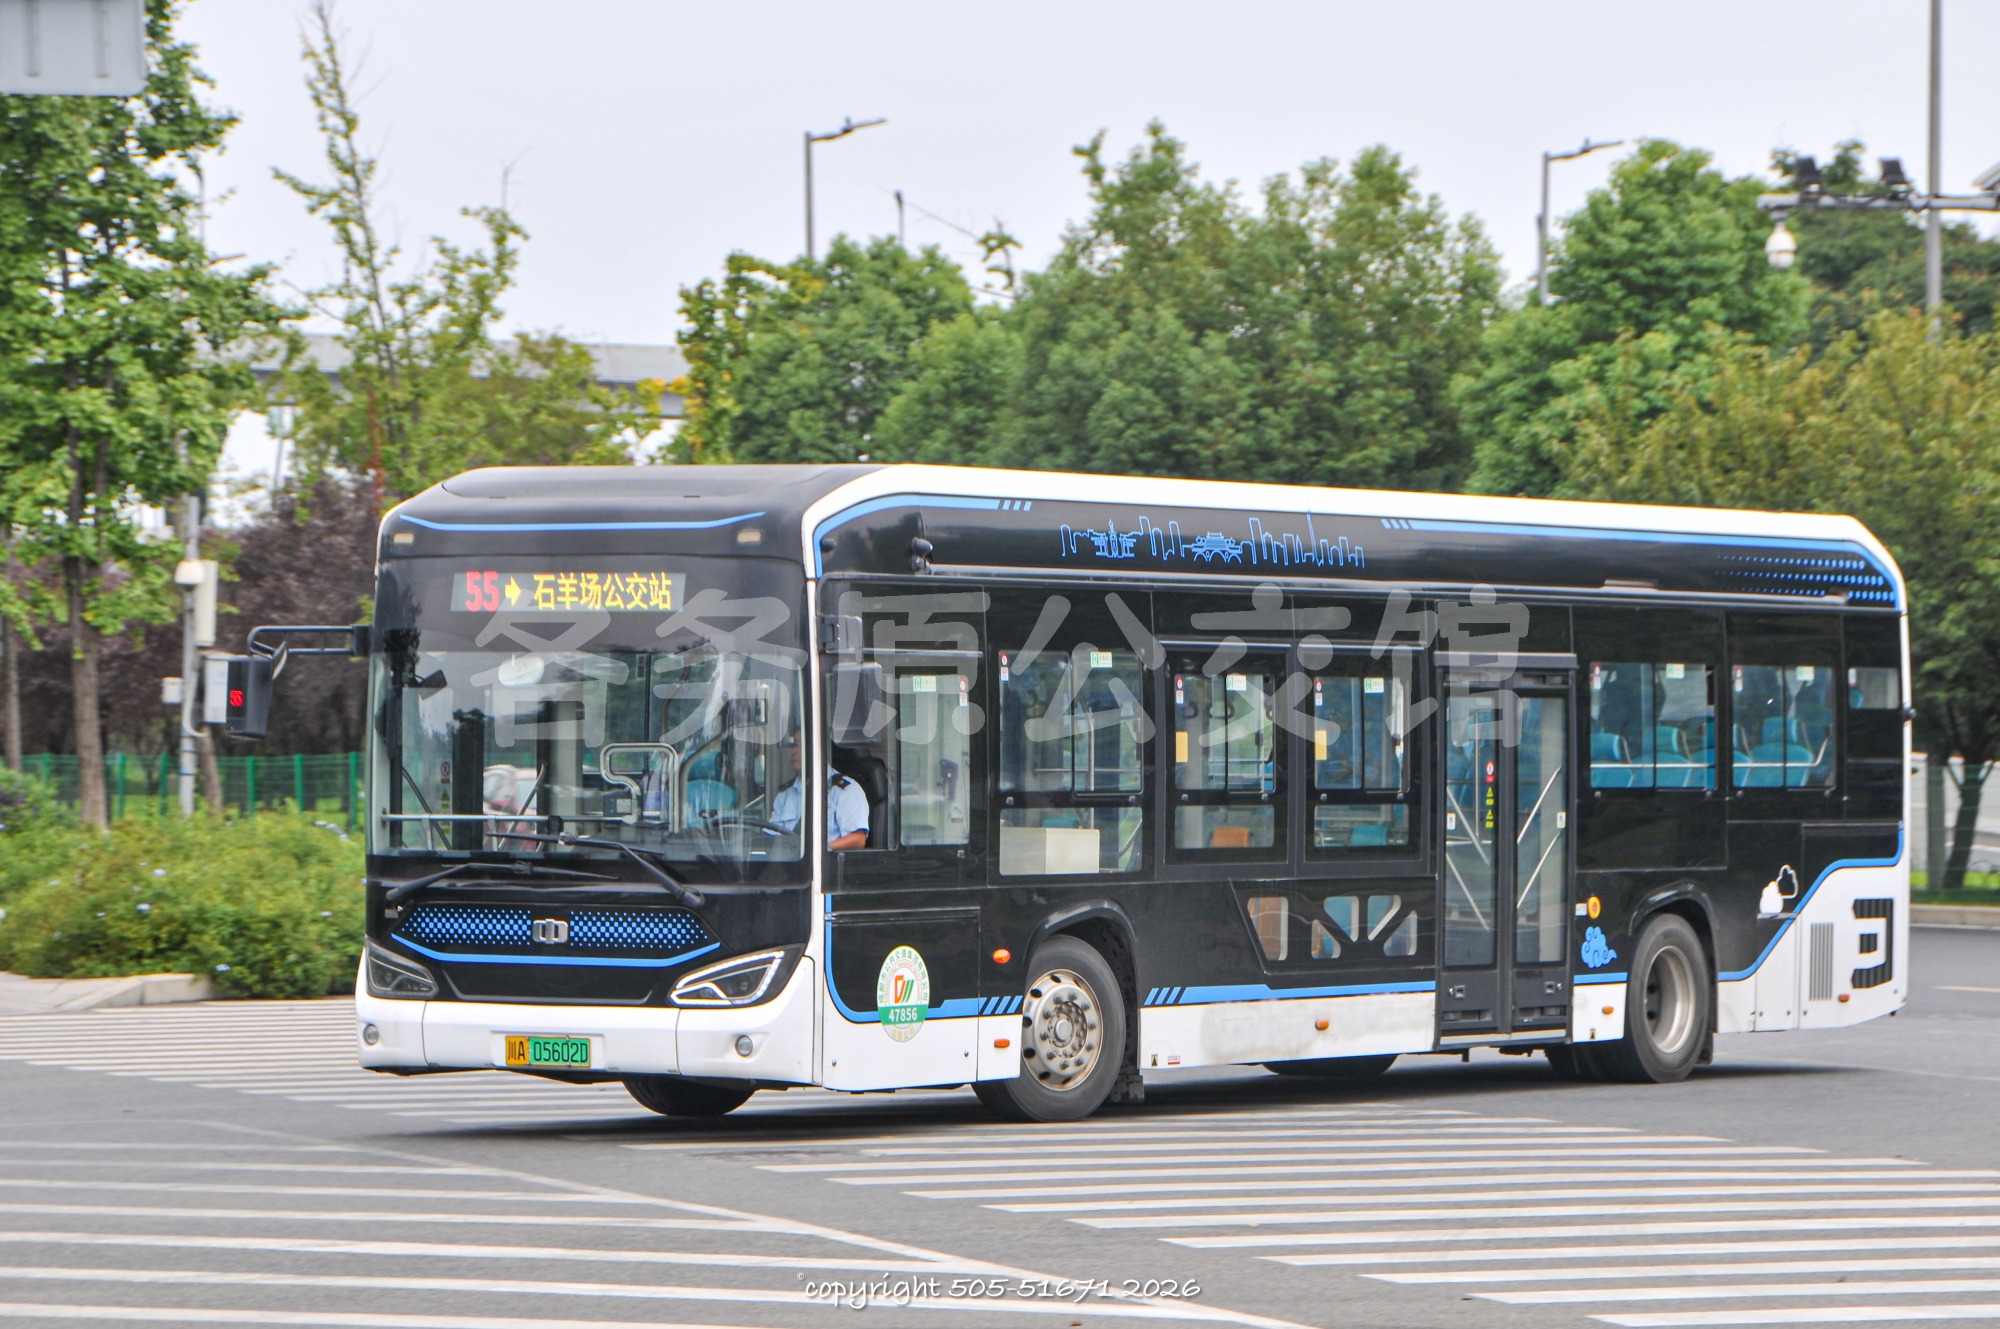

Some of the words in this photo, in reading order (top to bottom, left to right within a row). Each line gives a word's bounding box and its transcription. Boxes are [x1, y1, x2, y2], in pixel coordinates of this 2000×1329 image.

[466, 570, 500, 612] 55
[533, 571, 672, 610] 石羊场公交站
[888, 1007, 918, 1023] 47856
